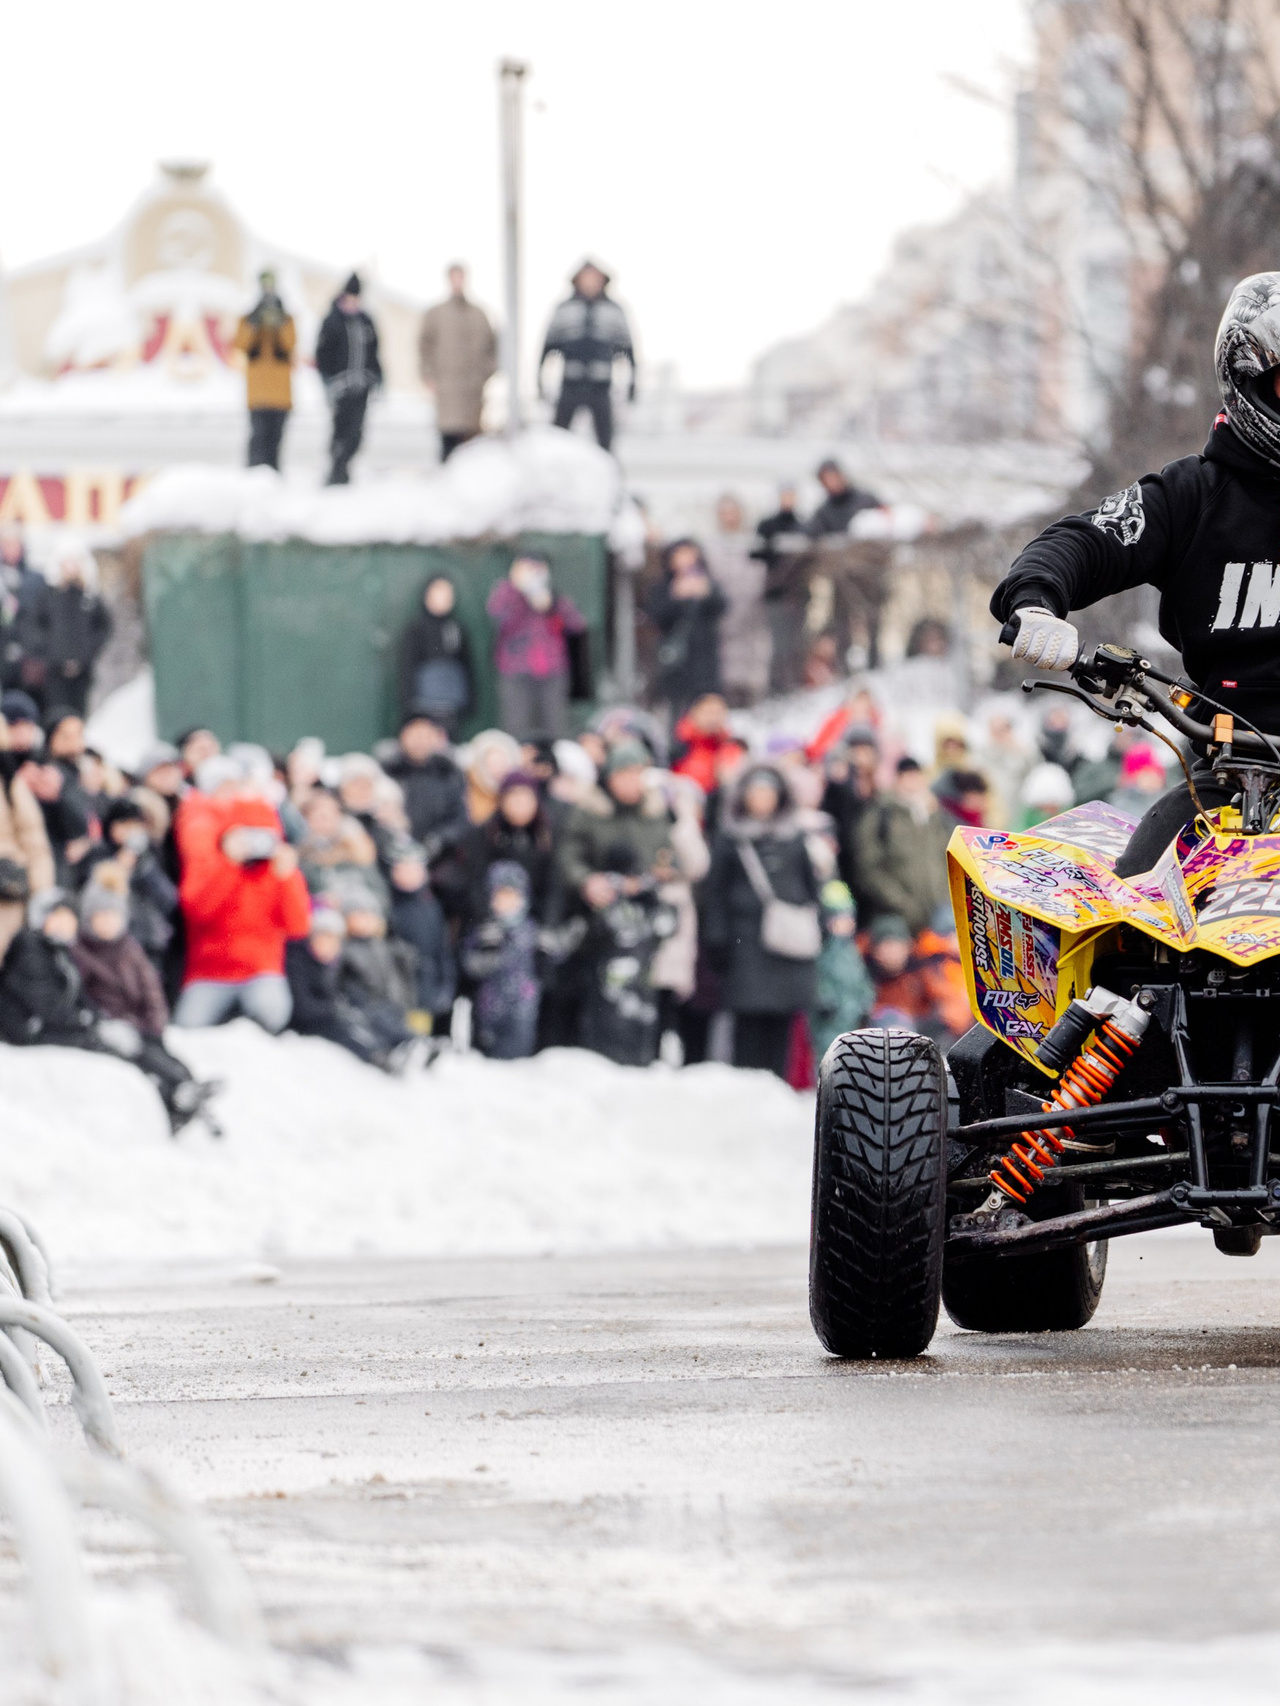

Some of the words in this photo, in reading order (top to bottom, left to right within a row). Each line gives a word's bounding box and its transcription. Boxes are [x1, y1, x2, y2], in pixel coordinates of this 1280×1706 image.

[975, 835, 1007, 850] VP
[1018, 848, 1071, 873] FOX
[970, 879, 988, 971] ASTHOUSE
[995, 902, 1014, 978] AMSOIL
[983, 990, 1019, 1008] FOX
[1005, 1020, 1044, 1034] GAV
